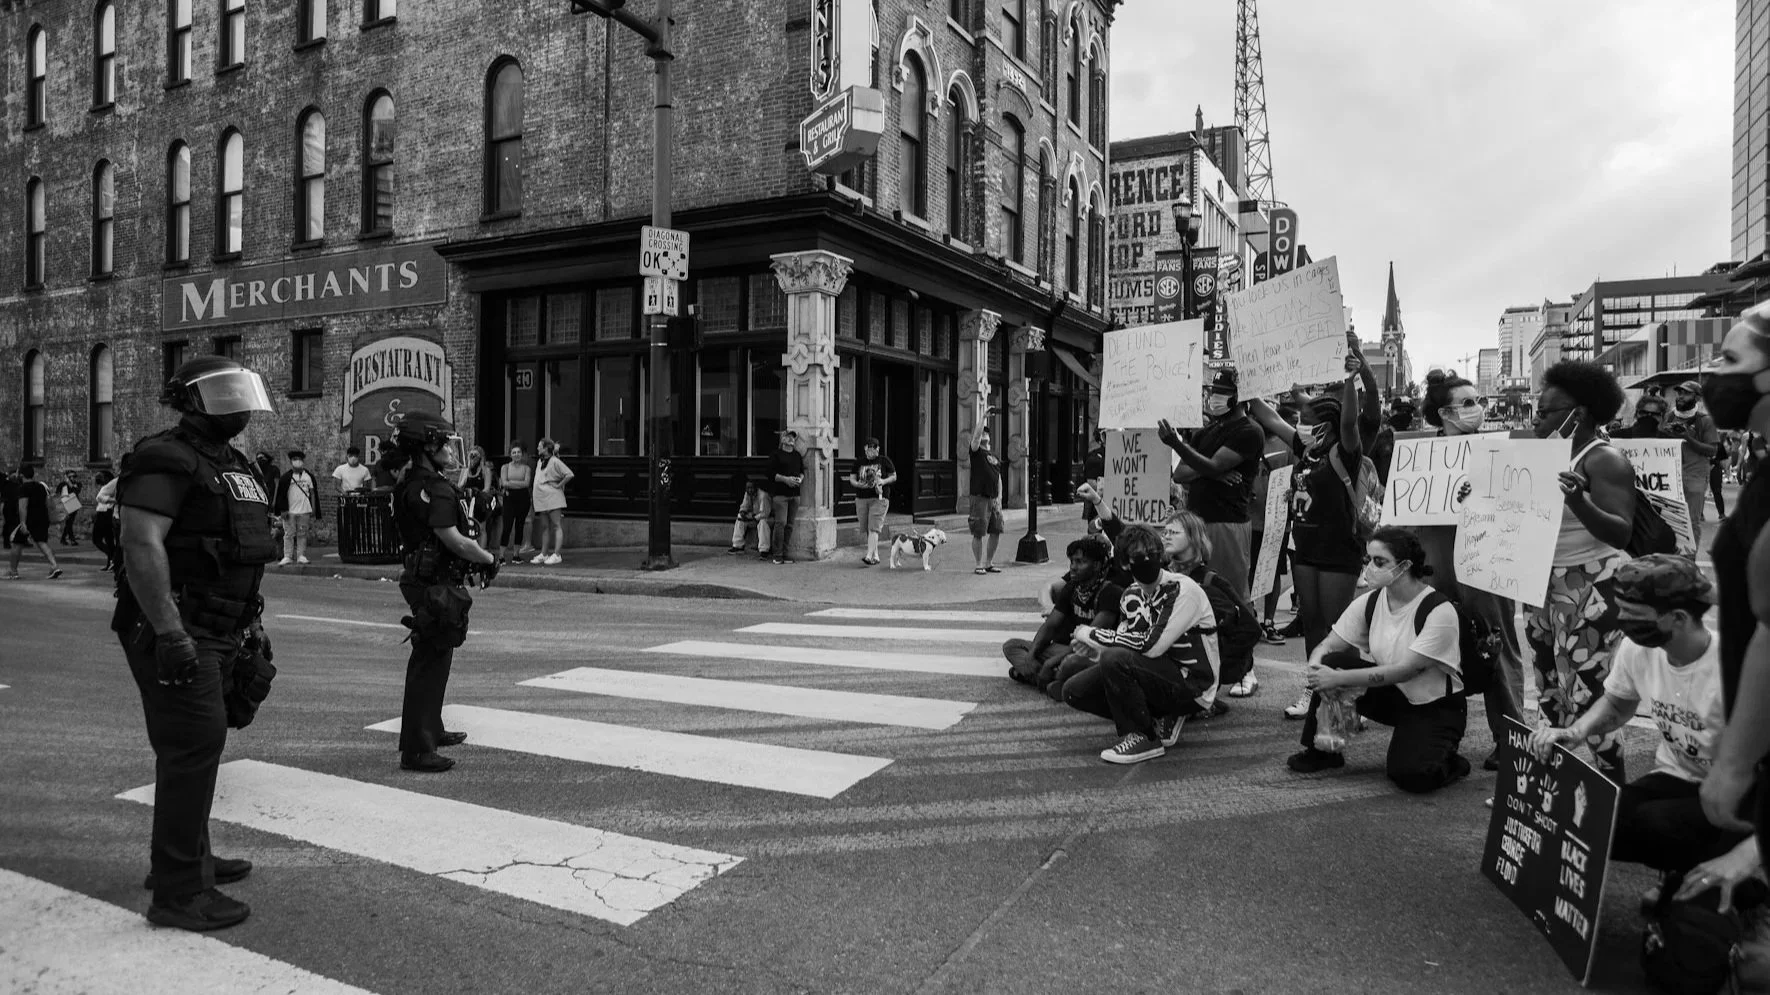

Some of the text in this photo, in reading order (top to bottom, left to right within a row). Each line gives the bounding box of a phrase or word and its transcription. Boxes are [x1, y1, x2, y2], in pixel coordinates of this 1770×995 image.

[813, 140, 819, 155] &
[648, 229, 682, 242] DIAGONAL
[648, 239, 683, 252] CROSSING
[1272, 217, 1290, 270] DOW
[643, 250, 661, 269] OK
[1157, 263, 1181, 272] FANS
[1193, 260, 1217, 271] FANS
[179, 260, 419, 323] MERCHANTS
[1160, 280, 1177, 296] SEC
[1196, 277, 1213, 294] SEC
[1108, 331, 1166, 359] DEFUND
[353, 348, 441, 395] RESTAURANT
[1113, 358, 1136, 377] THE
[384, 399, 405, 427] &
[1122, 432, 1141, 453] WE
[1643, 448, 1650, 457] A
[1655, 447, 1676, 457] TIME
[1113, 454, 1148, 475] WON'T
[1481, 449, 1533, 500] I am
[1124, 477, 1138, 496] BE
[1112, 496, 1167, 523] SILENCED
[1534, 810, 1559, 835] SHOOT
[1561, 840, 1588, 873] BLACK
[1559, 864, 1585, 900] LIVES
[1554, 896, 1589, 940] MATTER
